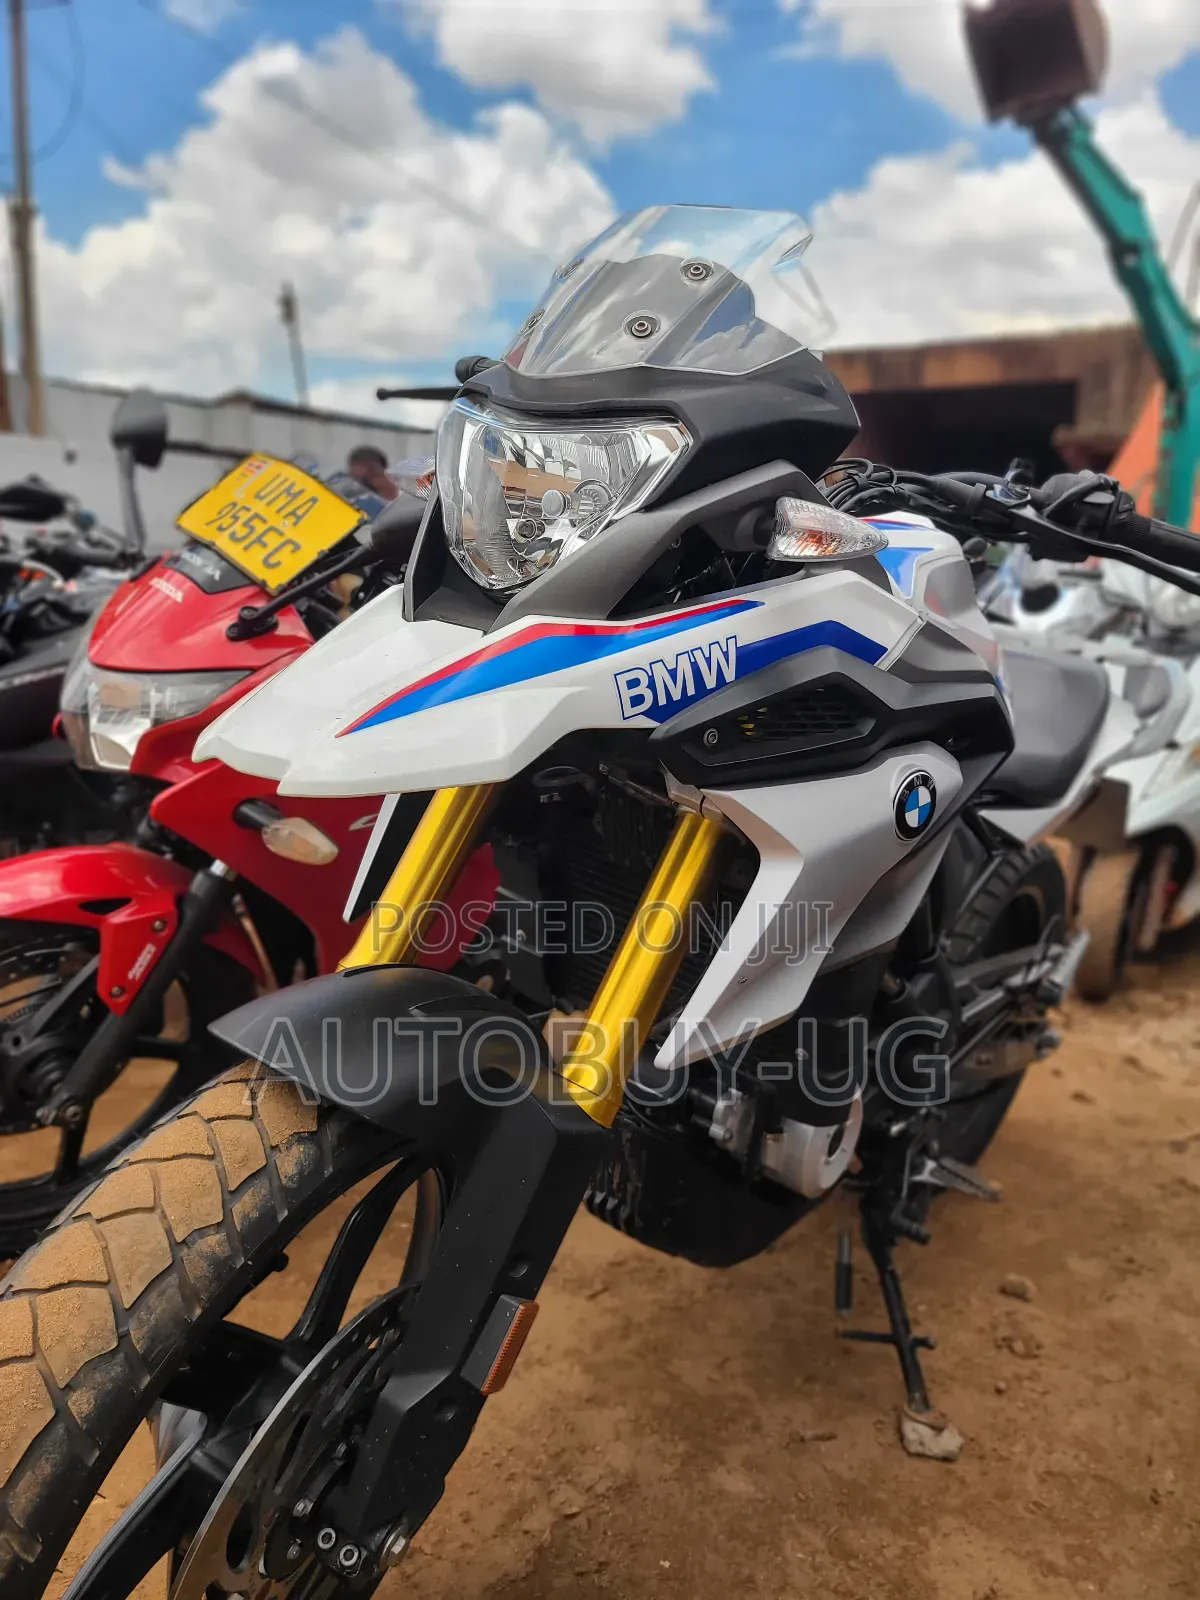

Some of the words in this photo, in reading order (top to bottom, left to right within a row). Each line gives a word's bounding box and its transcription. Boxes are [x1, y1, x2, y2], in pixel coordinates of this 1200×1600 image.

[254, 473, 318, 526] UMA
[205, 501, 302, 568] 955FC
[613, 635, 738, 720] BMW
[901, 774, 935, 801] BMW
